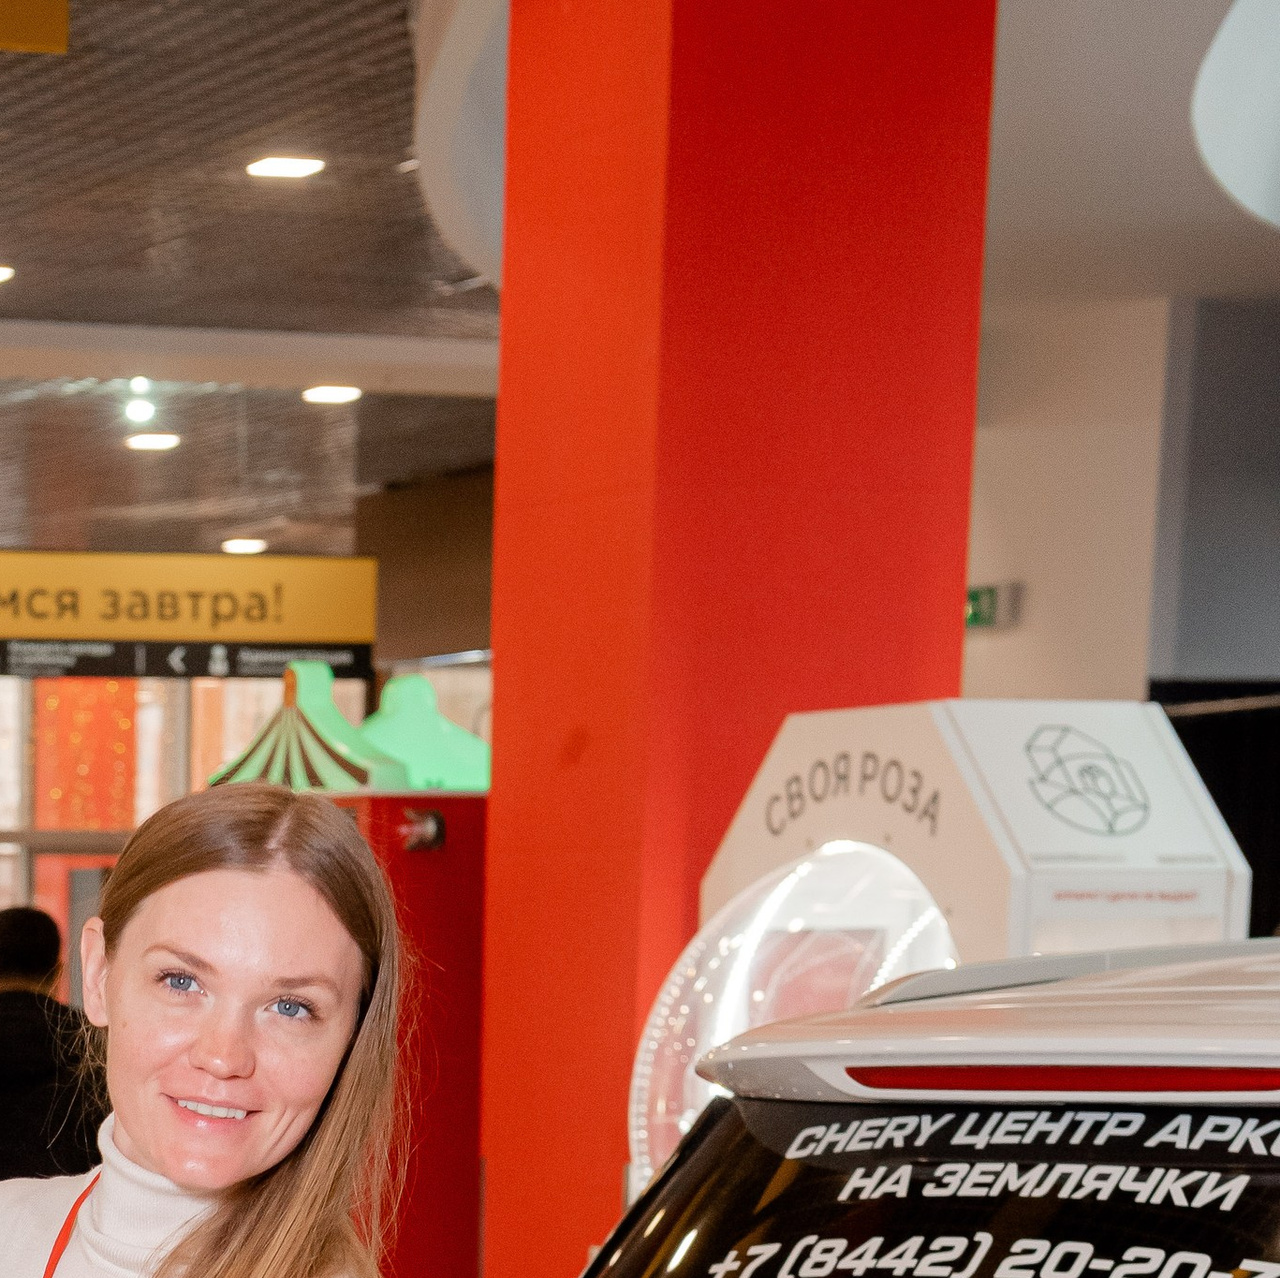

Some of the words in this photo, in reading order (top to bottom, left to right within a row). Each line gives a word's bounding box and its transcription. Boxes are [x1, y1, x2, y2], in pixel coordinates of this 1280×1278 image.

[99, 583, 286, 627] завтра!
[765, 752, 851, 836] СВОЯ
[858, 752, 941, 837] РОЗА
[785, 1113, 955, 1159] CHERY
[951, 1112, 1147, 1152] ЦЕНТР
[1143, 1113, 1280, 1157] АРК
[837, 1166, 910, 1202] НА
[922, 1162, 1251, 1211] ЗЕМЛЯЧКИ
